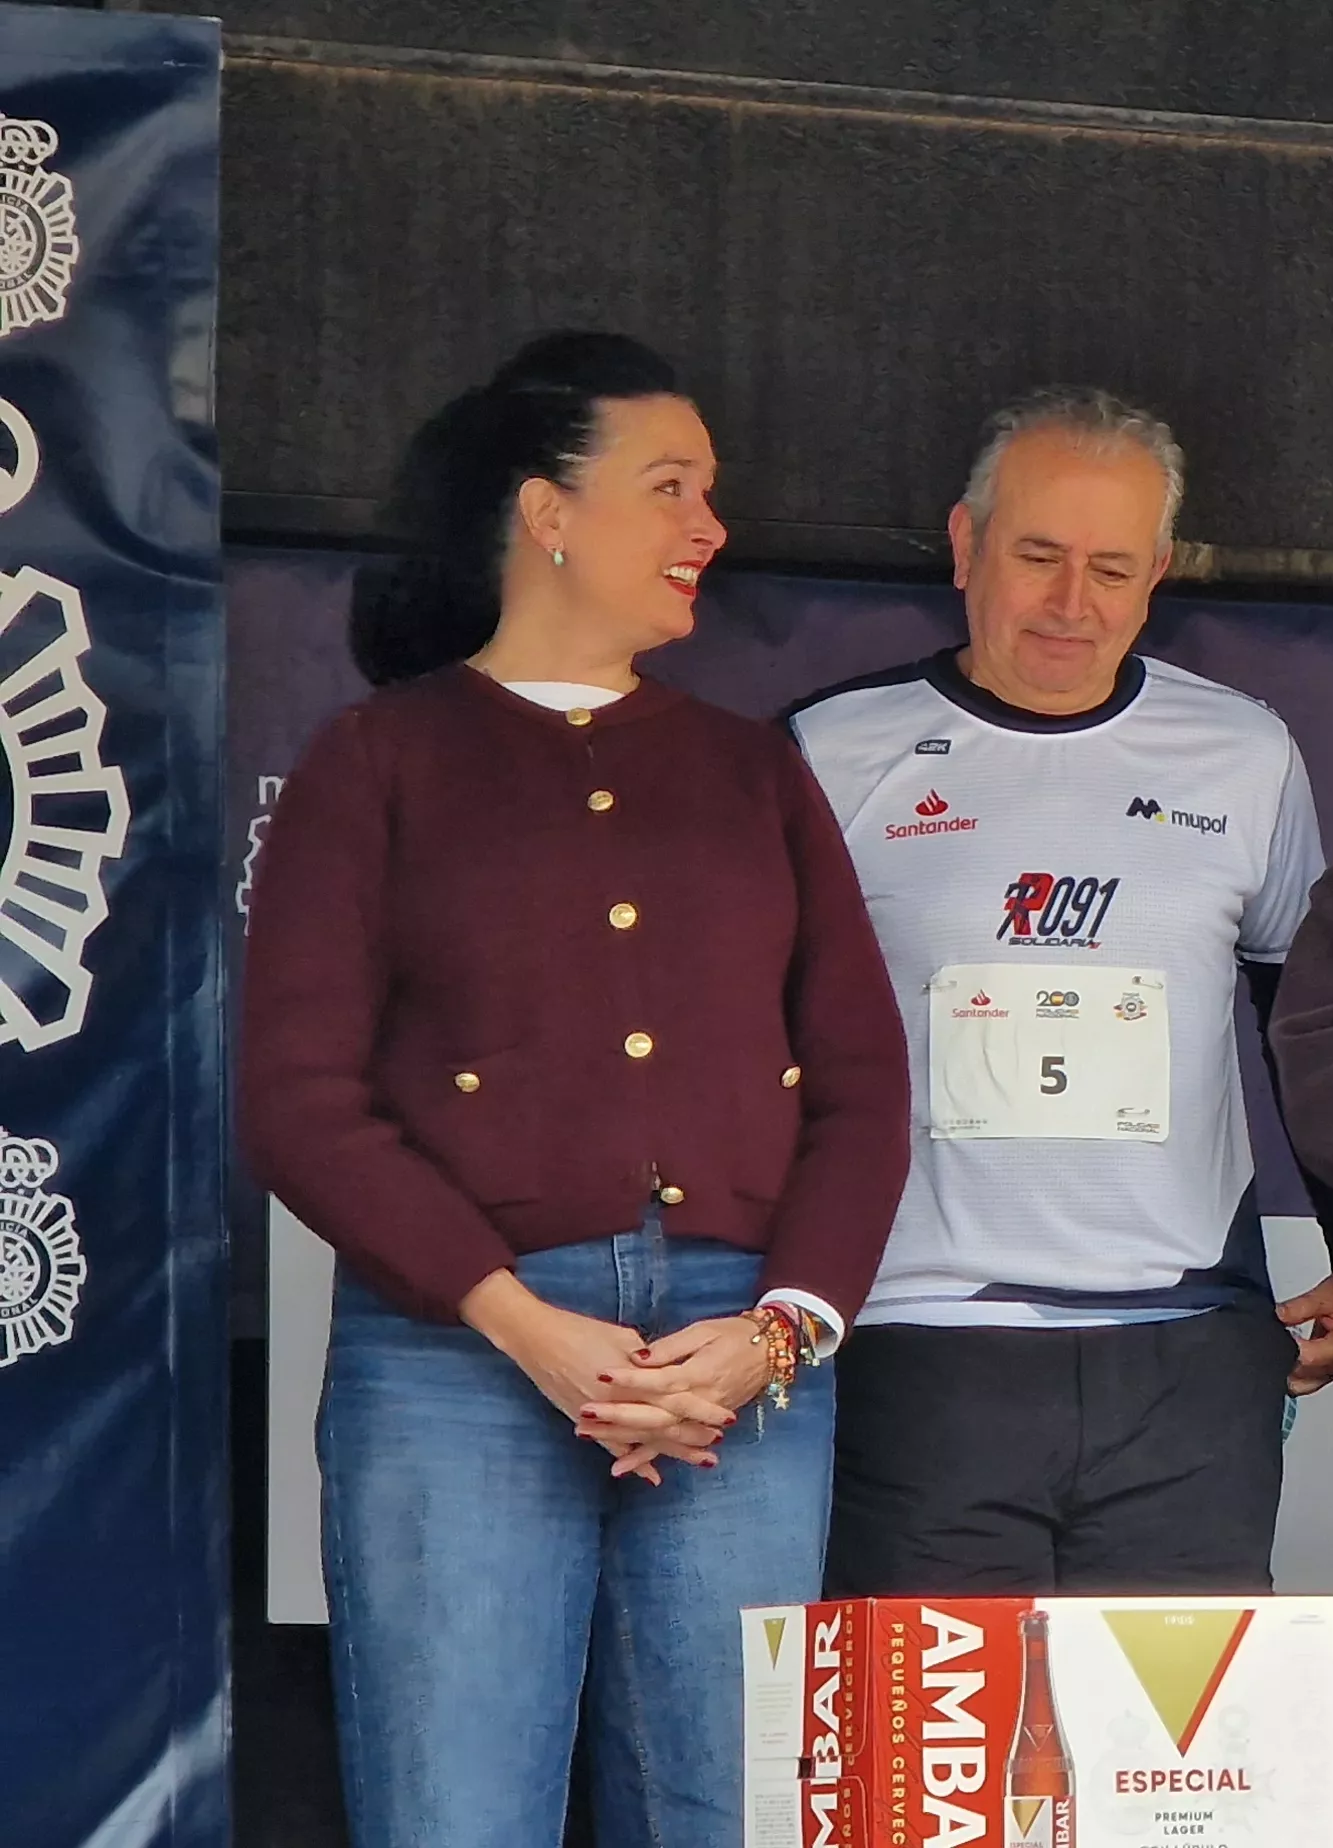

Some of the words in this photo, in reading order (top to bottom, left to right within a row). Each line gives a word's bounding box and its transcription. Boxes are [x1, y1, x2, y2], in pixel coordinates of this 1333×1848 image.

[885, 817, 979, 840] Santander
[1171, 809, 1228, 835] mupol
[951, 1007, 1010, 1018] Santander
[1040, 1056, 1068, 1095] 5
[891, 1623, 907, 1744] PEQUEÑOS
[811, 1606, 843, 1848] MBAR
[921, 1604, 987, 1848] AMBA
[1115, 1769, 1251, 1793] ESPECIAL
[892, 1756, 906, 1845] CERVEC
[1154, 1811, 1213, 1822] PREMIUM
[1055, 1799, 1071, 1848] BAR
[1163, 1825, 1204, 1835] LAGER
